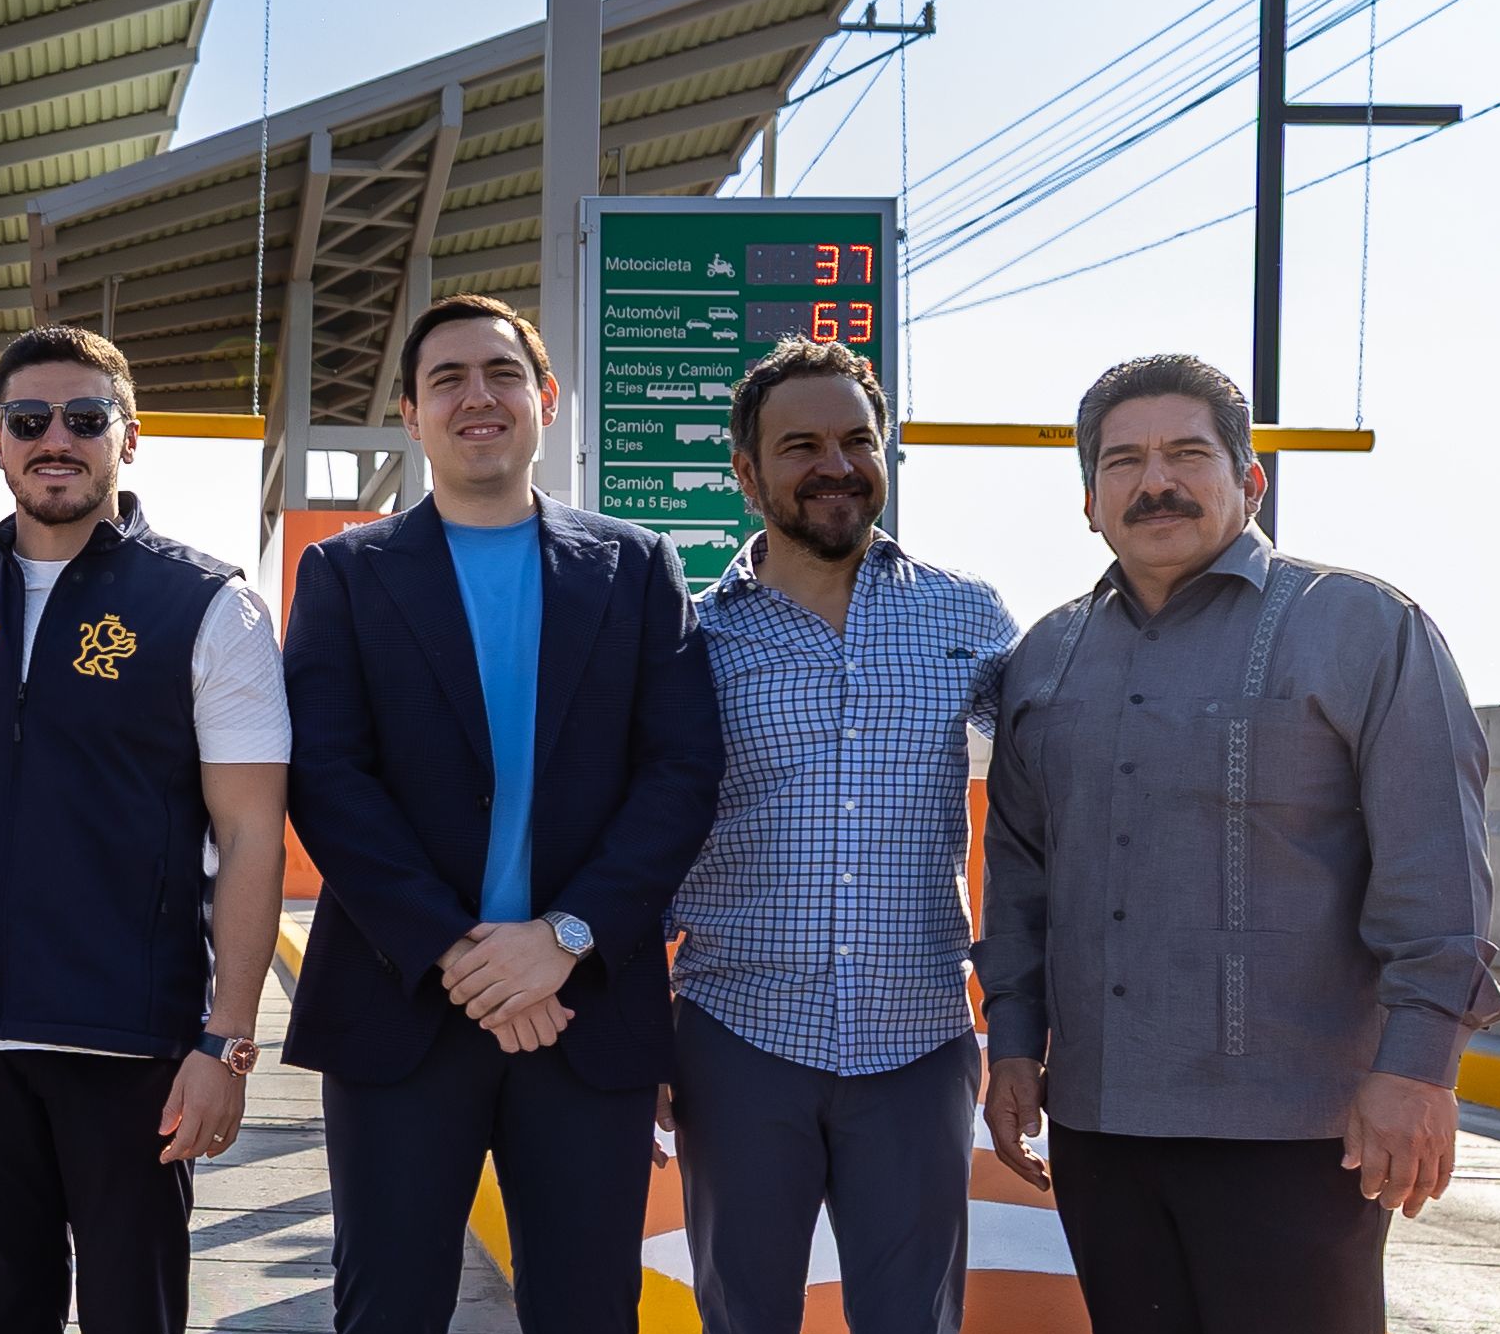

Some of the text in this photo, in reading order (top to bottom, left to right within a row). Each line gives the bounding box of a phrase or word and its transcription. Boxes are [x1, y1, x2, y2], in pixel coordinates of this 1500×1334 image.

[605, 257, 692, 272] Motocicleta
[815, 244, 873, 285] 37
[604, 304, 680, 320] Automóvil
[812, 301, 873, 343] 63
[604, 323, 687, 339] Camioneta
[605, 362, 732, 380] Autobús y Camión
[604, 381, 644, 396] 2 Ejes
[605, 418, 664, 433] Camión
[1039, 428, 1074, 438] ALTUR
[604, 438, 643, 453] 3 Ejes
[604, 475, 664, 490] Camión
[604, 495, 687, 511] De 4 a 5 Ejes
